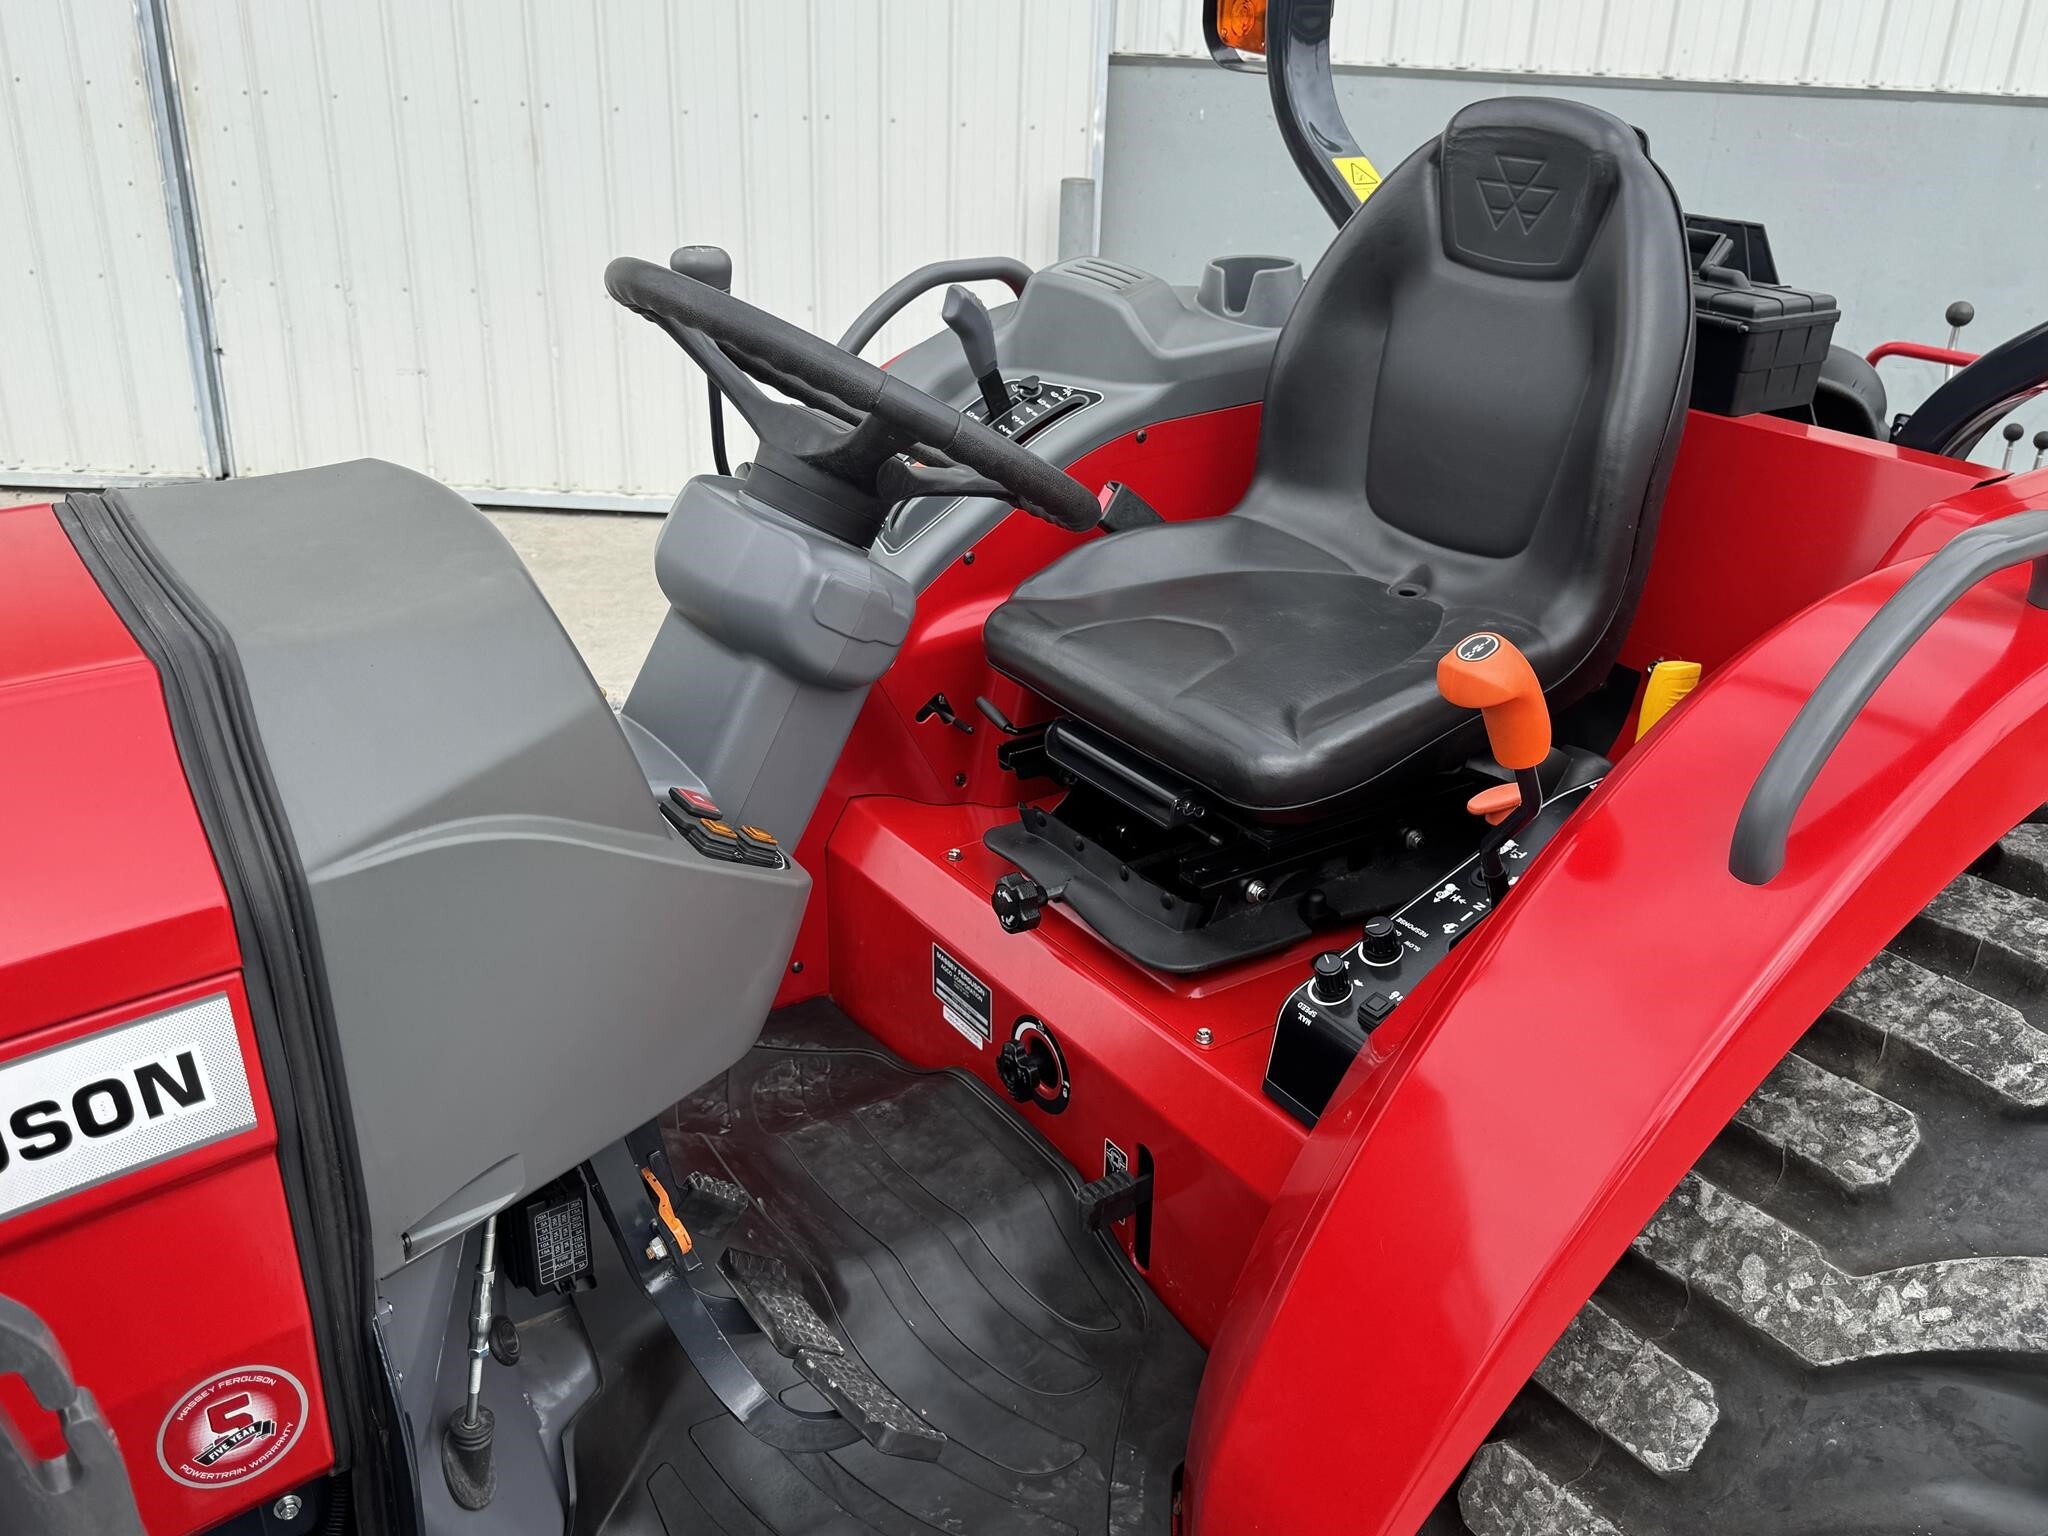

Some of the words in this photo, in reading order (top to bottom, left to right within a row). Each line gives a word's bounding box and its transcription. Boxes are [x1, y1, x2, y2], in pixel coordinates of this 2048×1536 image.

[1396, 917, 1430, 938] RESPONSE
[1297, 1001, 1318, 1018] SPEED
[0, 1050, 206, 1173] SON
[177, 1386, 215, 1421] MASSEY
[218, 1375, 277, 1390] FERGUSON
[180, 1463, 247, 1480] POWERTRAIN
[248, 1421, 294, 1469] WARRANTY
[208, 1443, 231, 1461] FIVE
[231, 1426, 257, 1444] YEAR
